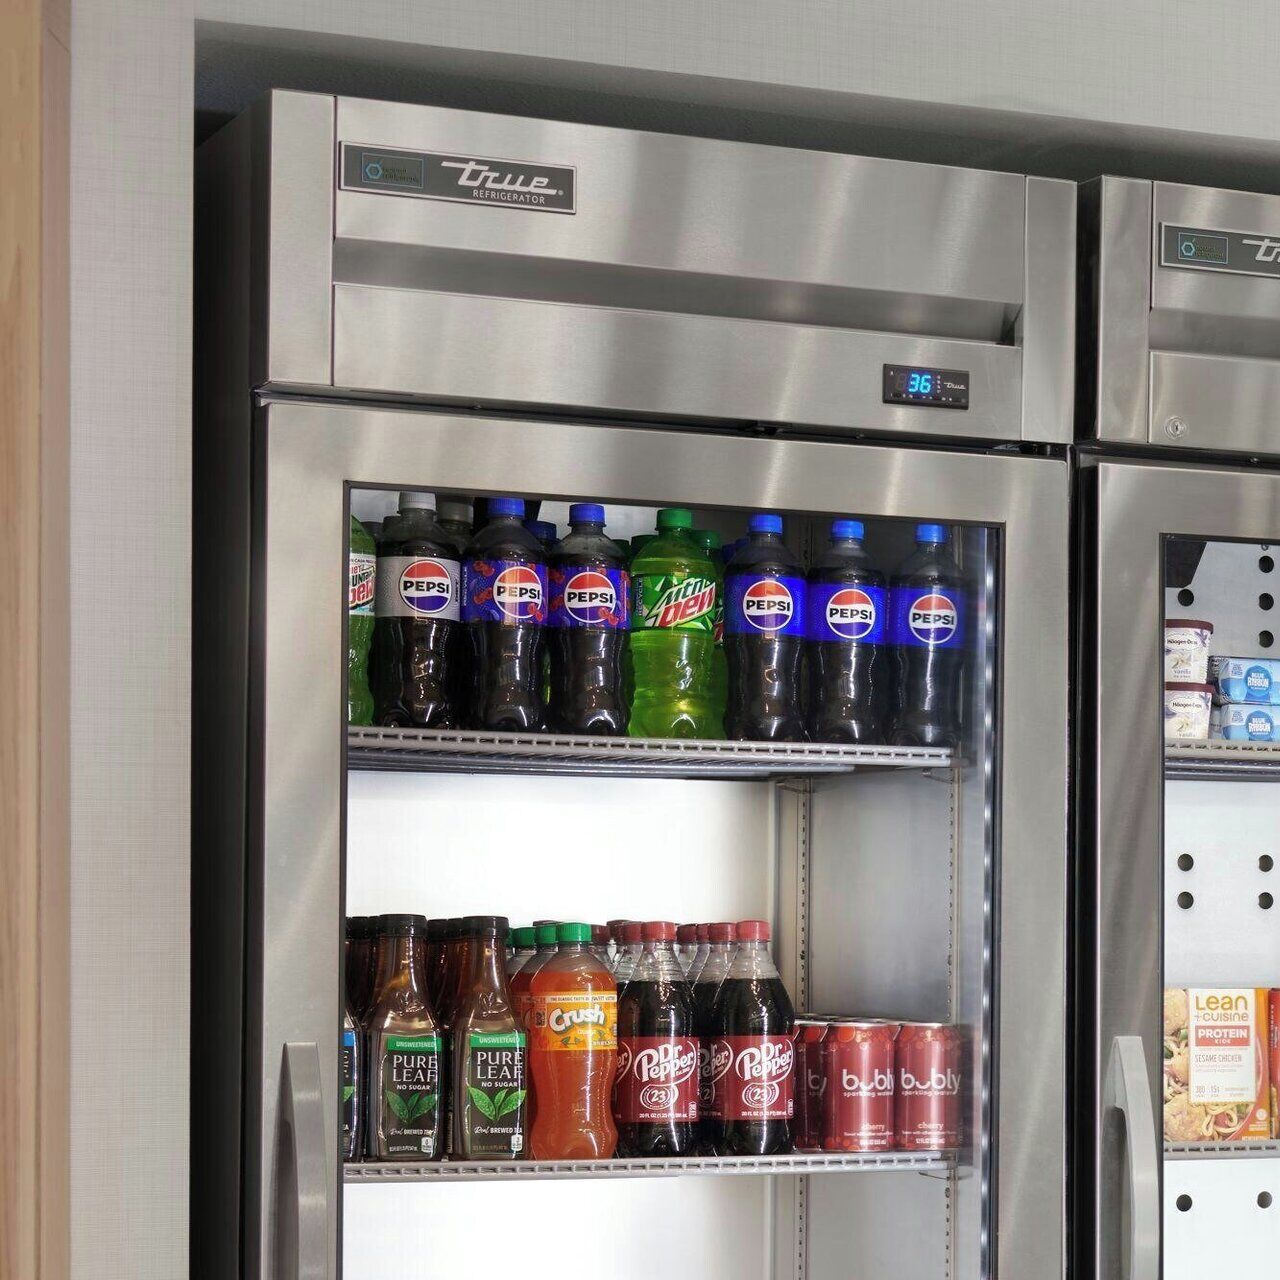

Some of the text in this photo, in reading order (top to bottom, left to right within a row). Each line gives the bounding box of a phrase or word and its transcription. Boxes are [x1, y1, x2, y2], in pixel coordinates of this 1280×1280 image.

[472, 189, 546, 205] REFRIGERATOR
[908, 373, 932, 393] 36
[403, 580, 450, 594] PEPSI
[496, 585, 541, 600] PEPSI
[1196, 995, 1248, 1011] Lean
[549, 1003, 605, 1034] Crush
[1198, 1029, 1248, 1039] PROTEIN
[476, 1051, 523, 1065] PURE
[658, 1044, 683, 1062] Dr
[1194, 1054, 1242, 1063] SESAME CHICKEN
[476, 1066, 523, 1080] LEAF
[639, 1049, 695, 1082] Pepper
[901, 1067, 962, 1094] bubly
[651, 1090, 666, 1102] 23
[917, 1121, 944, 1131] cherry
